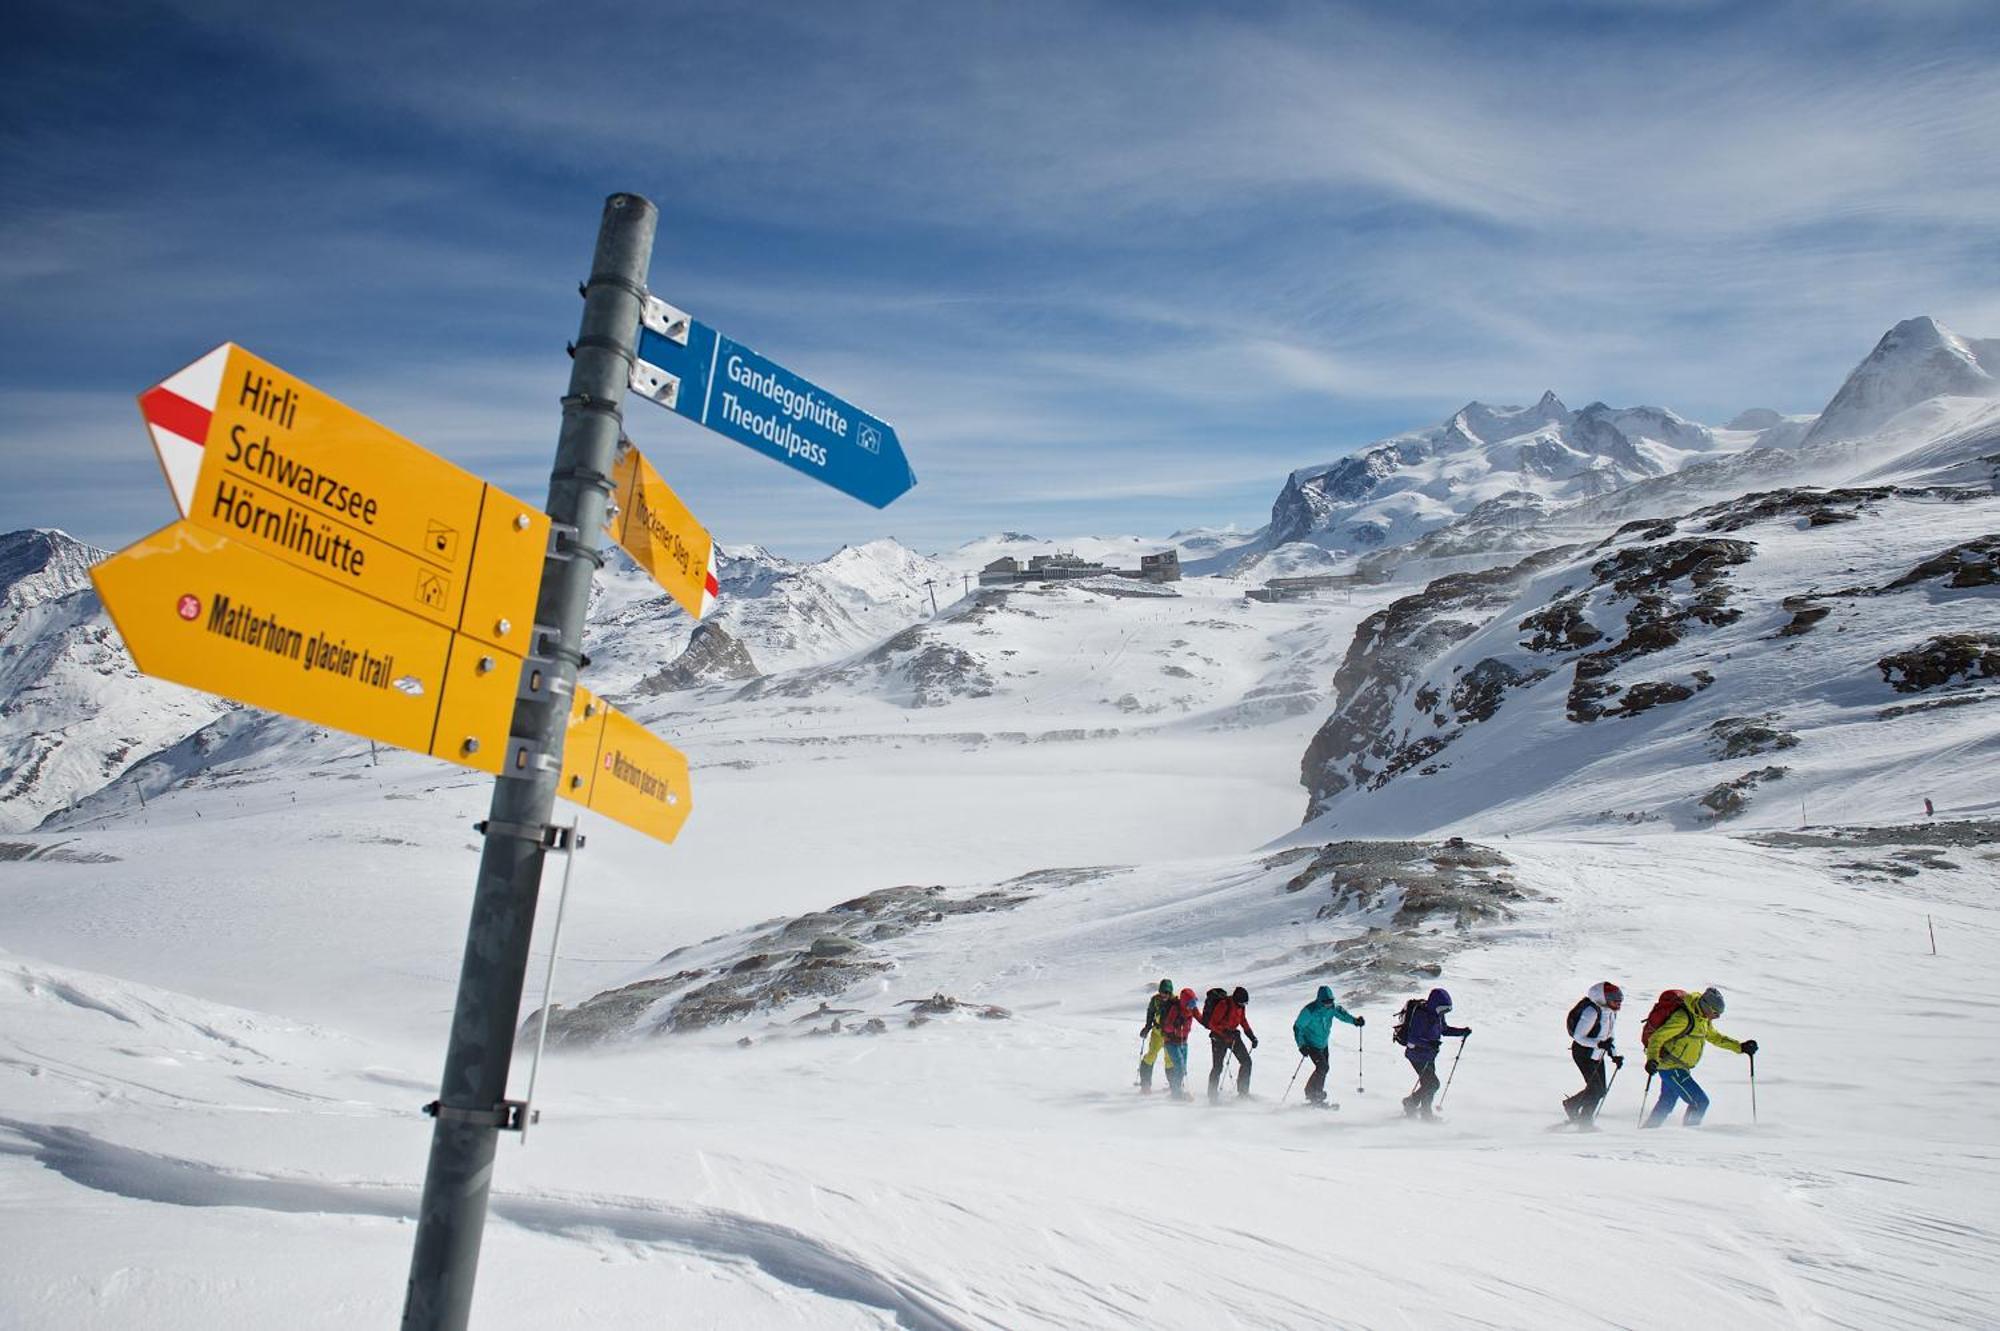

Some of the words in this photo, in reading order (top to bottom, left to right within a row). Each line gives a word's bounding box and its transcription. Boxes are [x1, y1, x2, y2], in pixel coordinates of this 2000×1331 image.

[239, 371, 298, 430] Hirli
[721, 392, 828, 466] Theodulpass
[727, 355, 848, 438] Gandegghütte
[226, 424, 377, 525] Schwarzsee
[213, 480, 365, 576] Hörnlihütte
[207, 593, 303, 660] Matterhorn
[304, 632, 359, 671] glacier
[359, 649, 394, 690] trail
